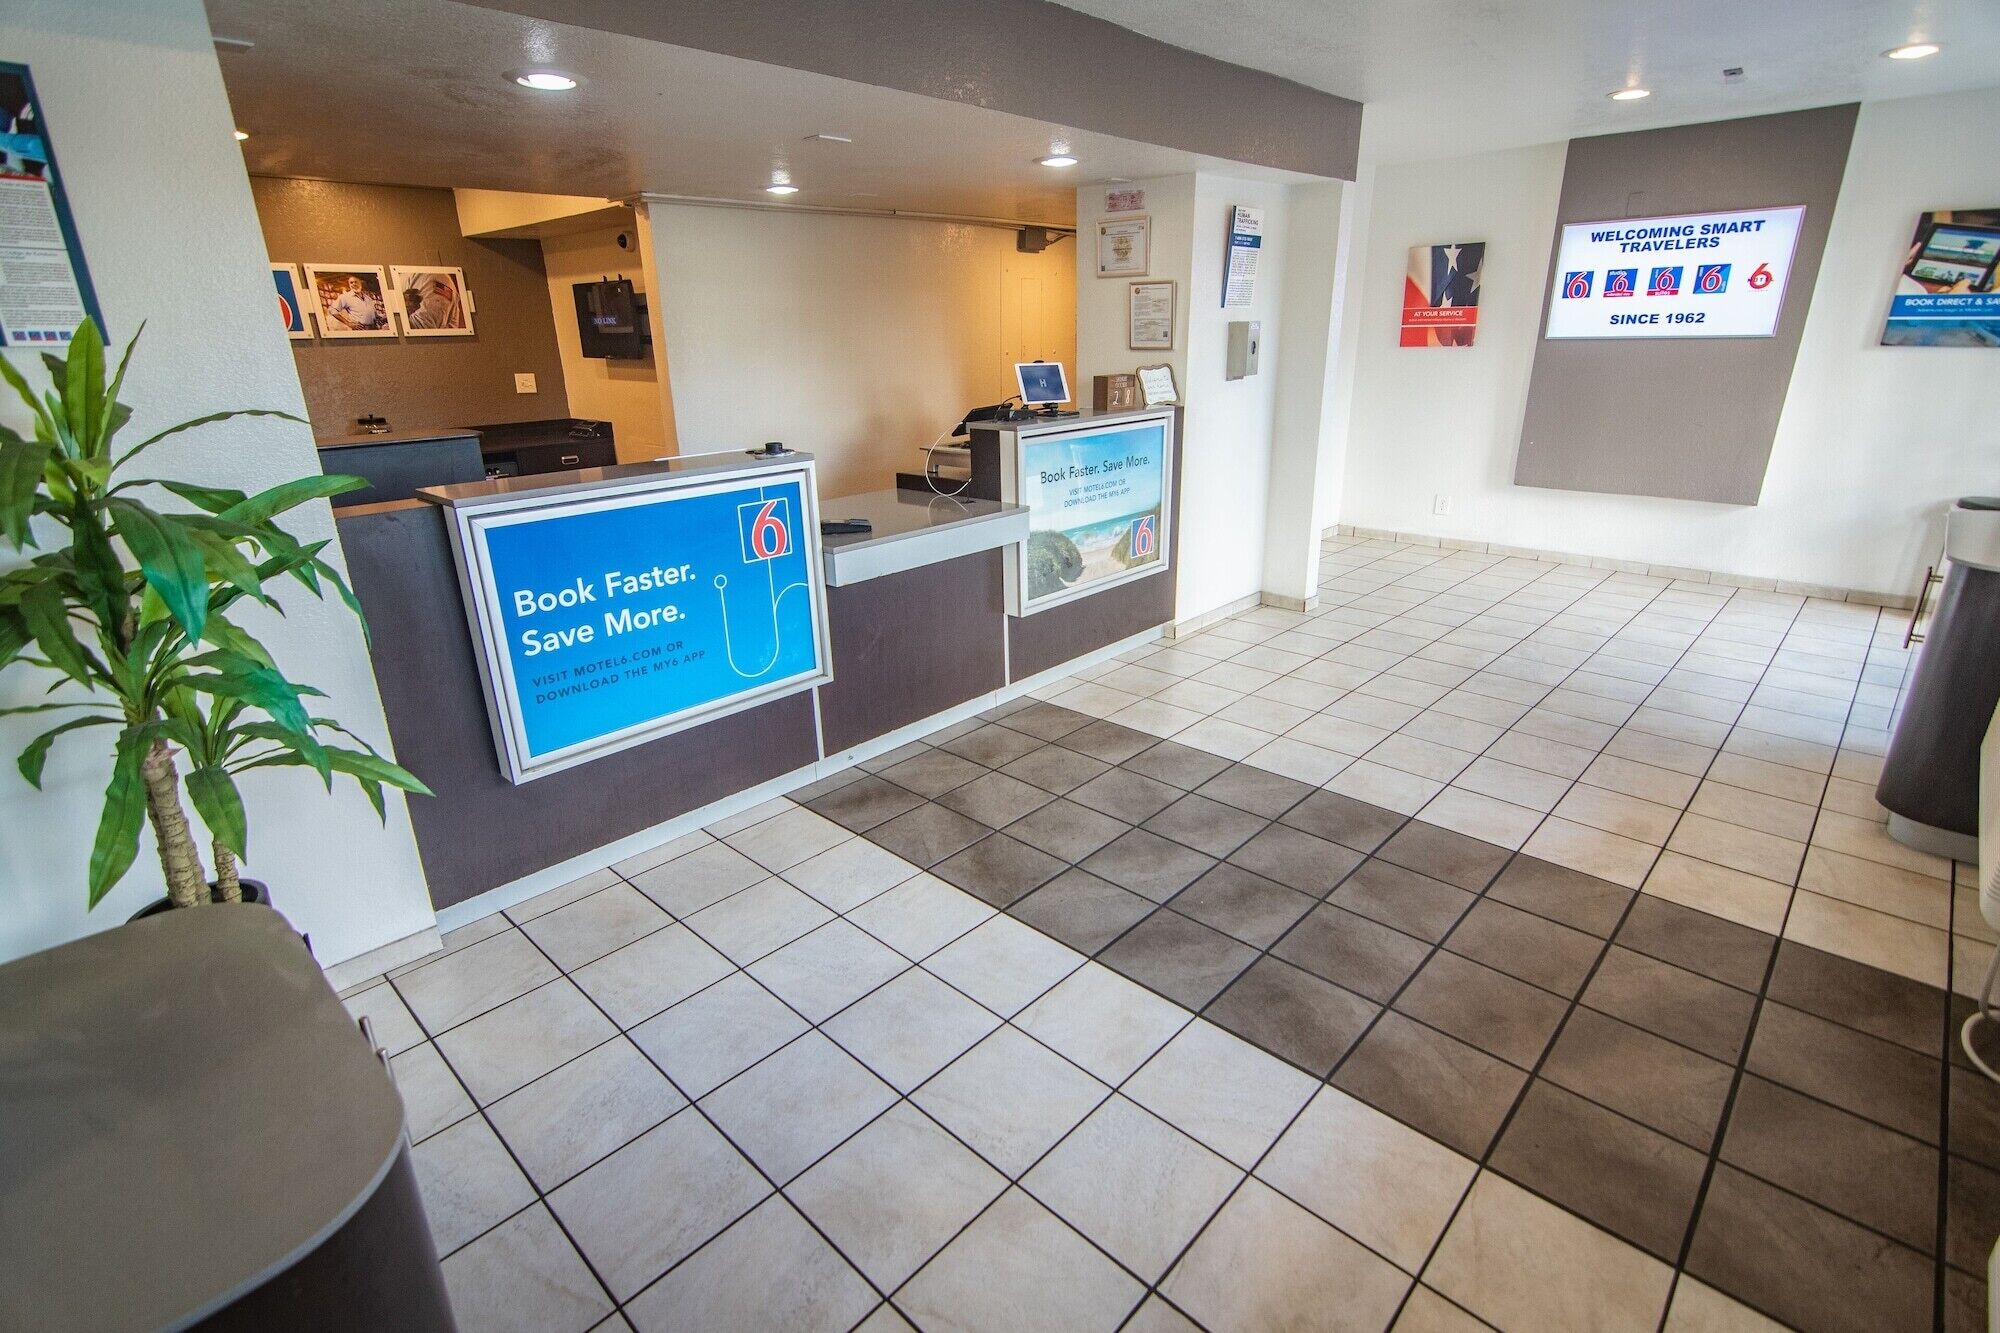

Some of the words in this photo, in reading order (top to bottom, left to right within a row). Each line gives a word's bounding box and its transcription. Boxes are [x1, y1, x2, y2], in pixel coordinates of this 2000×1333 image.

[1591, 225, 1694, 243] WELCOMING
[1700, 220, 1766, 235] SMART
[1619, 236, 1720, 253] TRAVELERS
[1567, 271, 1589, 299] 6
[1612, 274, 1629, 292] 6
[1655, 266, 1675, 290] 6
[1702, 265, 1722, 293] 6
[1904, 298, 1934, 306] BOOK
[1936, 298, 1973, 306] DIRECT
[1975, 298, 1983, 306] &
[1609, 313, 1660, 325] SINCE
[1666, 312, 1706, 324] 1962
[1040, 467, 1066, 484] Book
[1069, 465, 1100, 479] Faster.
[1102, 460, 1123, 473] Save
[1126, 456, 1150, 468] More.
[1064, 494, 1097, 508] DOWNLOAD
[1098, 491, 1108, 500] THE
[1120, 487, 1131, 496] APP
[1069, 487, 1082, 496] VISIT
[1084, 480, 1118, 494] MOTEL6.COM
[1118, 478, 1126, 486] OR
[752, 500, 788, 560] 6
[1135, 516, 1153, 556] 6
[513, 576, 597, 618] Book
[604, 563, 696, 598] Faster.
[521, 623, 595, 657] Save
[604, 603, 686, 637] More.
[532, 670, 568, 688] VISIT
[573, 646, 662, 678] MOTEL6.COM
[666, 640, 684, 652] OR
[535, 673, 620, 705] DOWNLOAD
[623, 666, 649, 680] THE
[653, 657, 679, 672] MY6
[683, 650, 706, 664] APP
